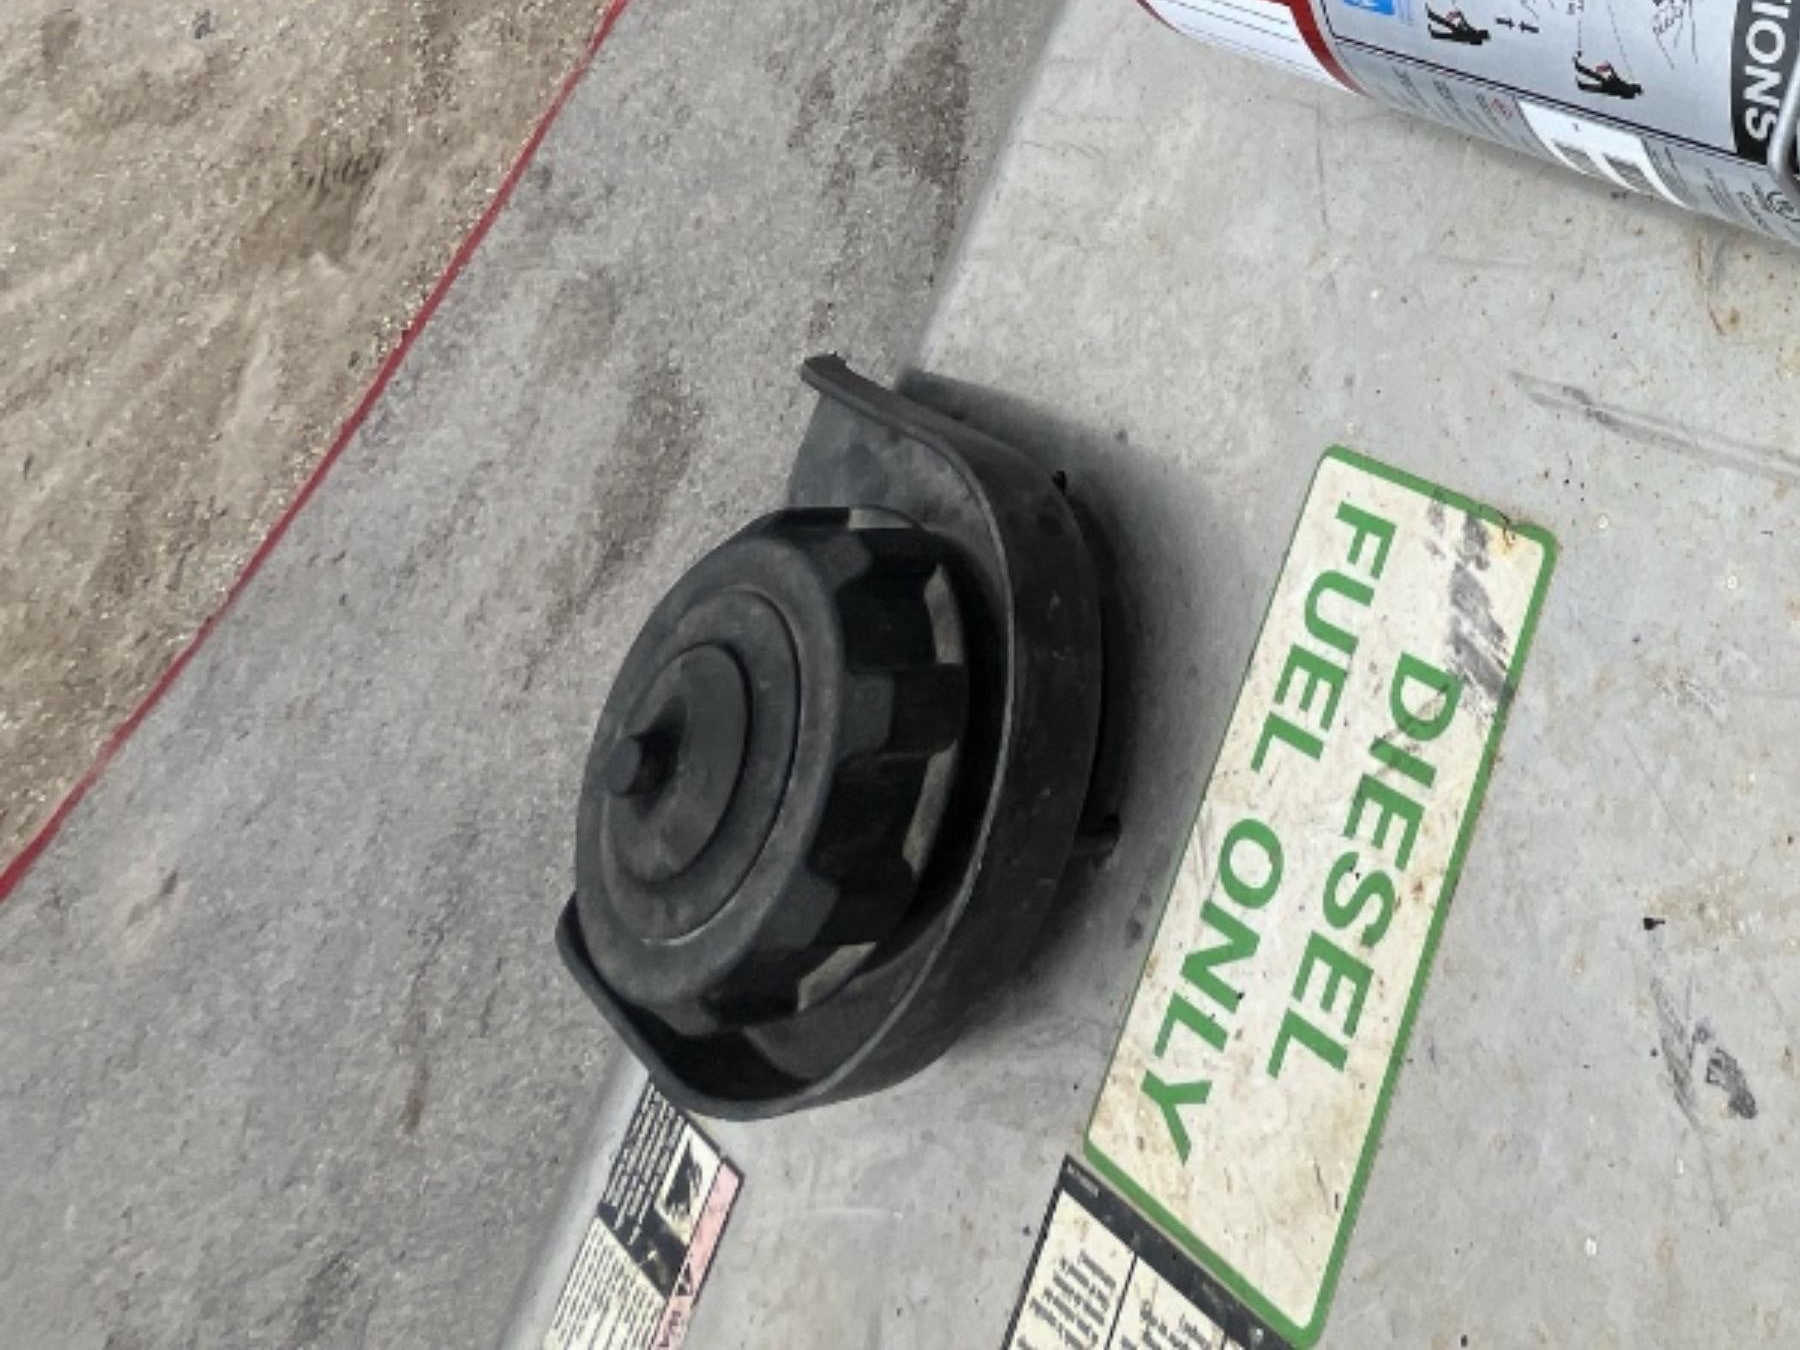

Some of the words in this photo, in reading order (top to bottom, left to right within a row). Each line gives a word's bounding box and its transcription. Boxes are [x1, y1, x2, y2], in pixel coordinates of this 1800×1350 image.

[1250, 500, 1396, 775] FUEL
[1138, 816, 1287, 1168] ONLY
[1266, 652, 1465, 1081] DIESEL
